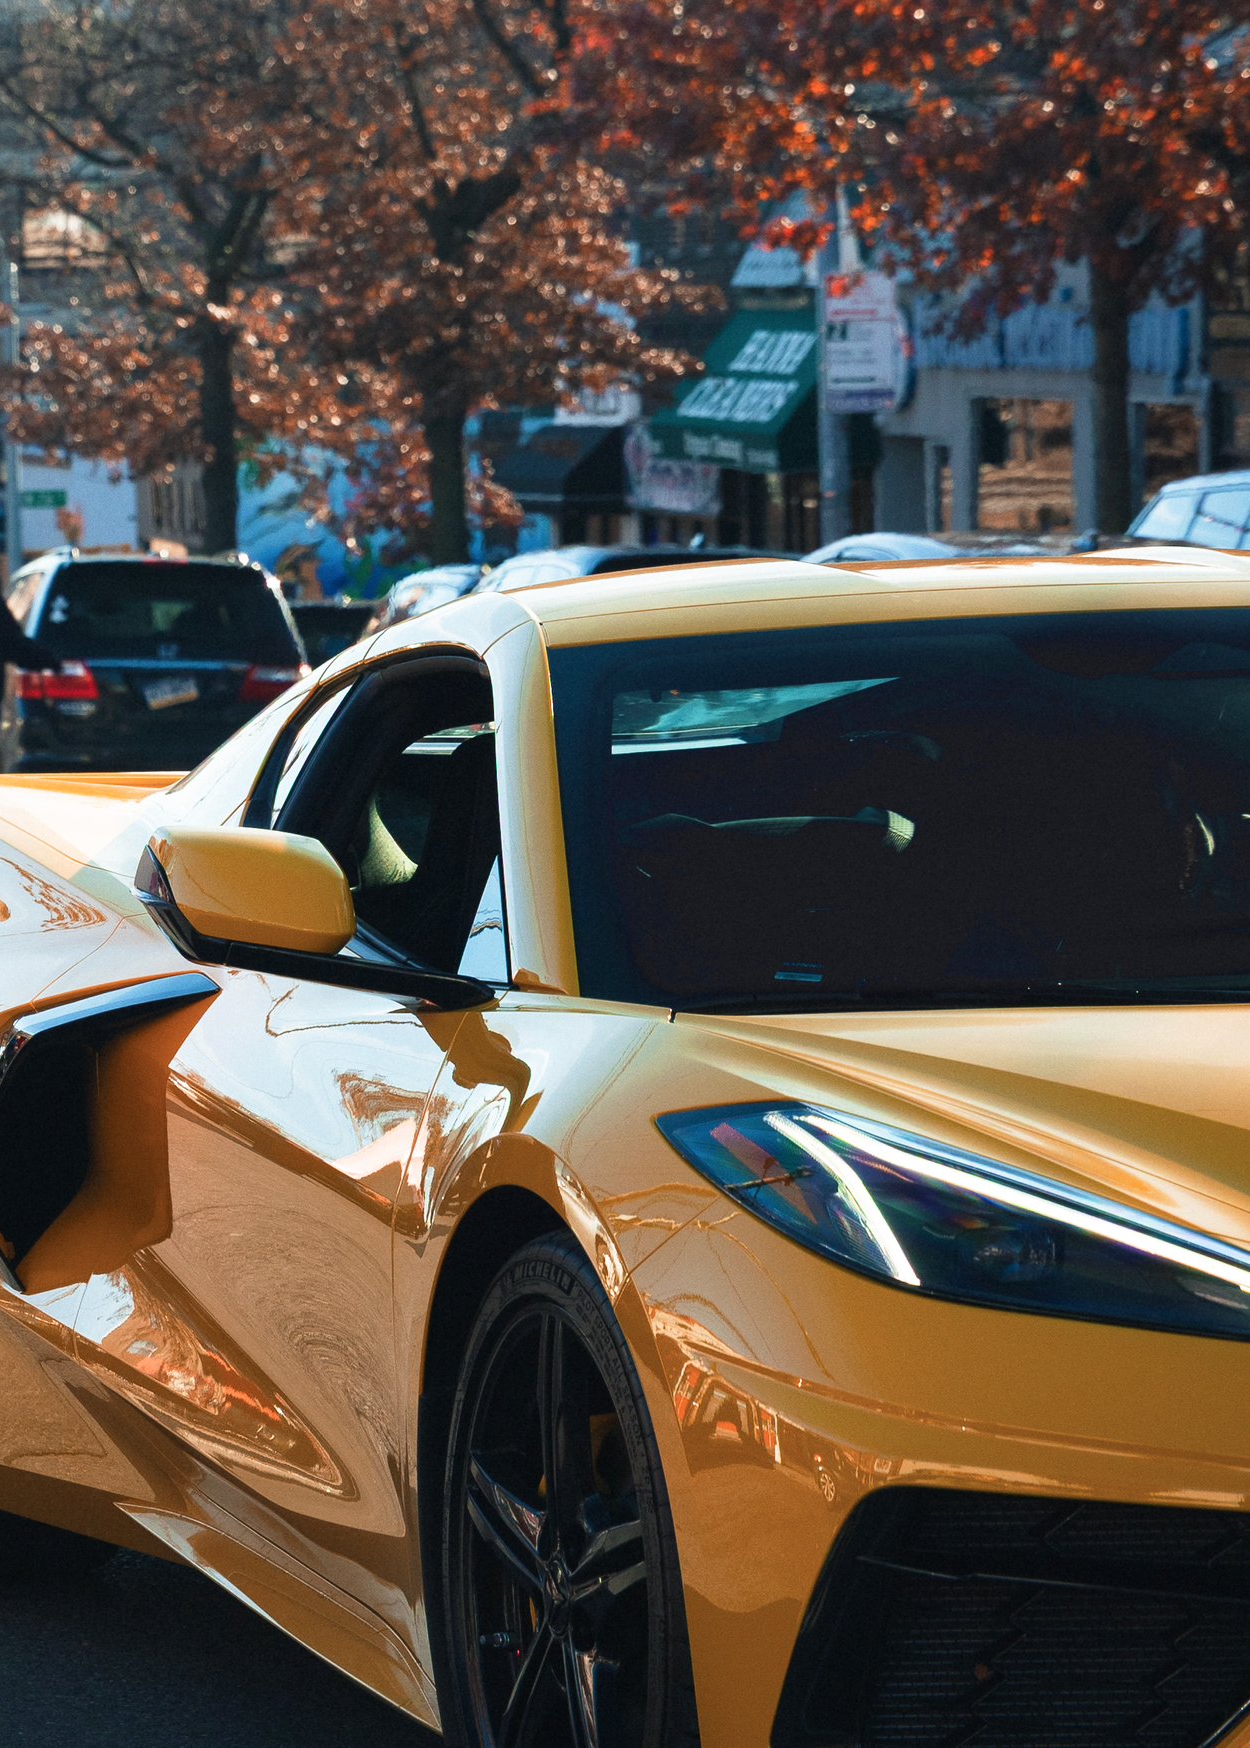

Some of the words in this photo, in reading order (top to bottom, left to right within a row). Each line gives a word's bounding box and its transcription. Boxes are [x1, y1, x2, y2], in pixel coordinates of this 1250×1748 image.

[514, 1260, 573, 1295] MICHELIN
[577, 1289, 596, 1316] PILOT
[594, 1316, 615, 1351] SPORT
[612, 1358, 625, 1382] ALL
[621, 1385, 643, 1446] SEASON
